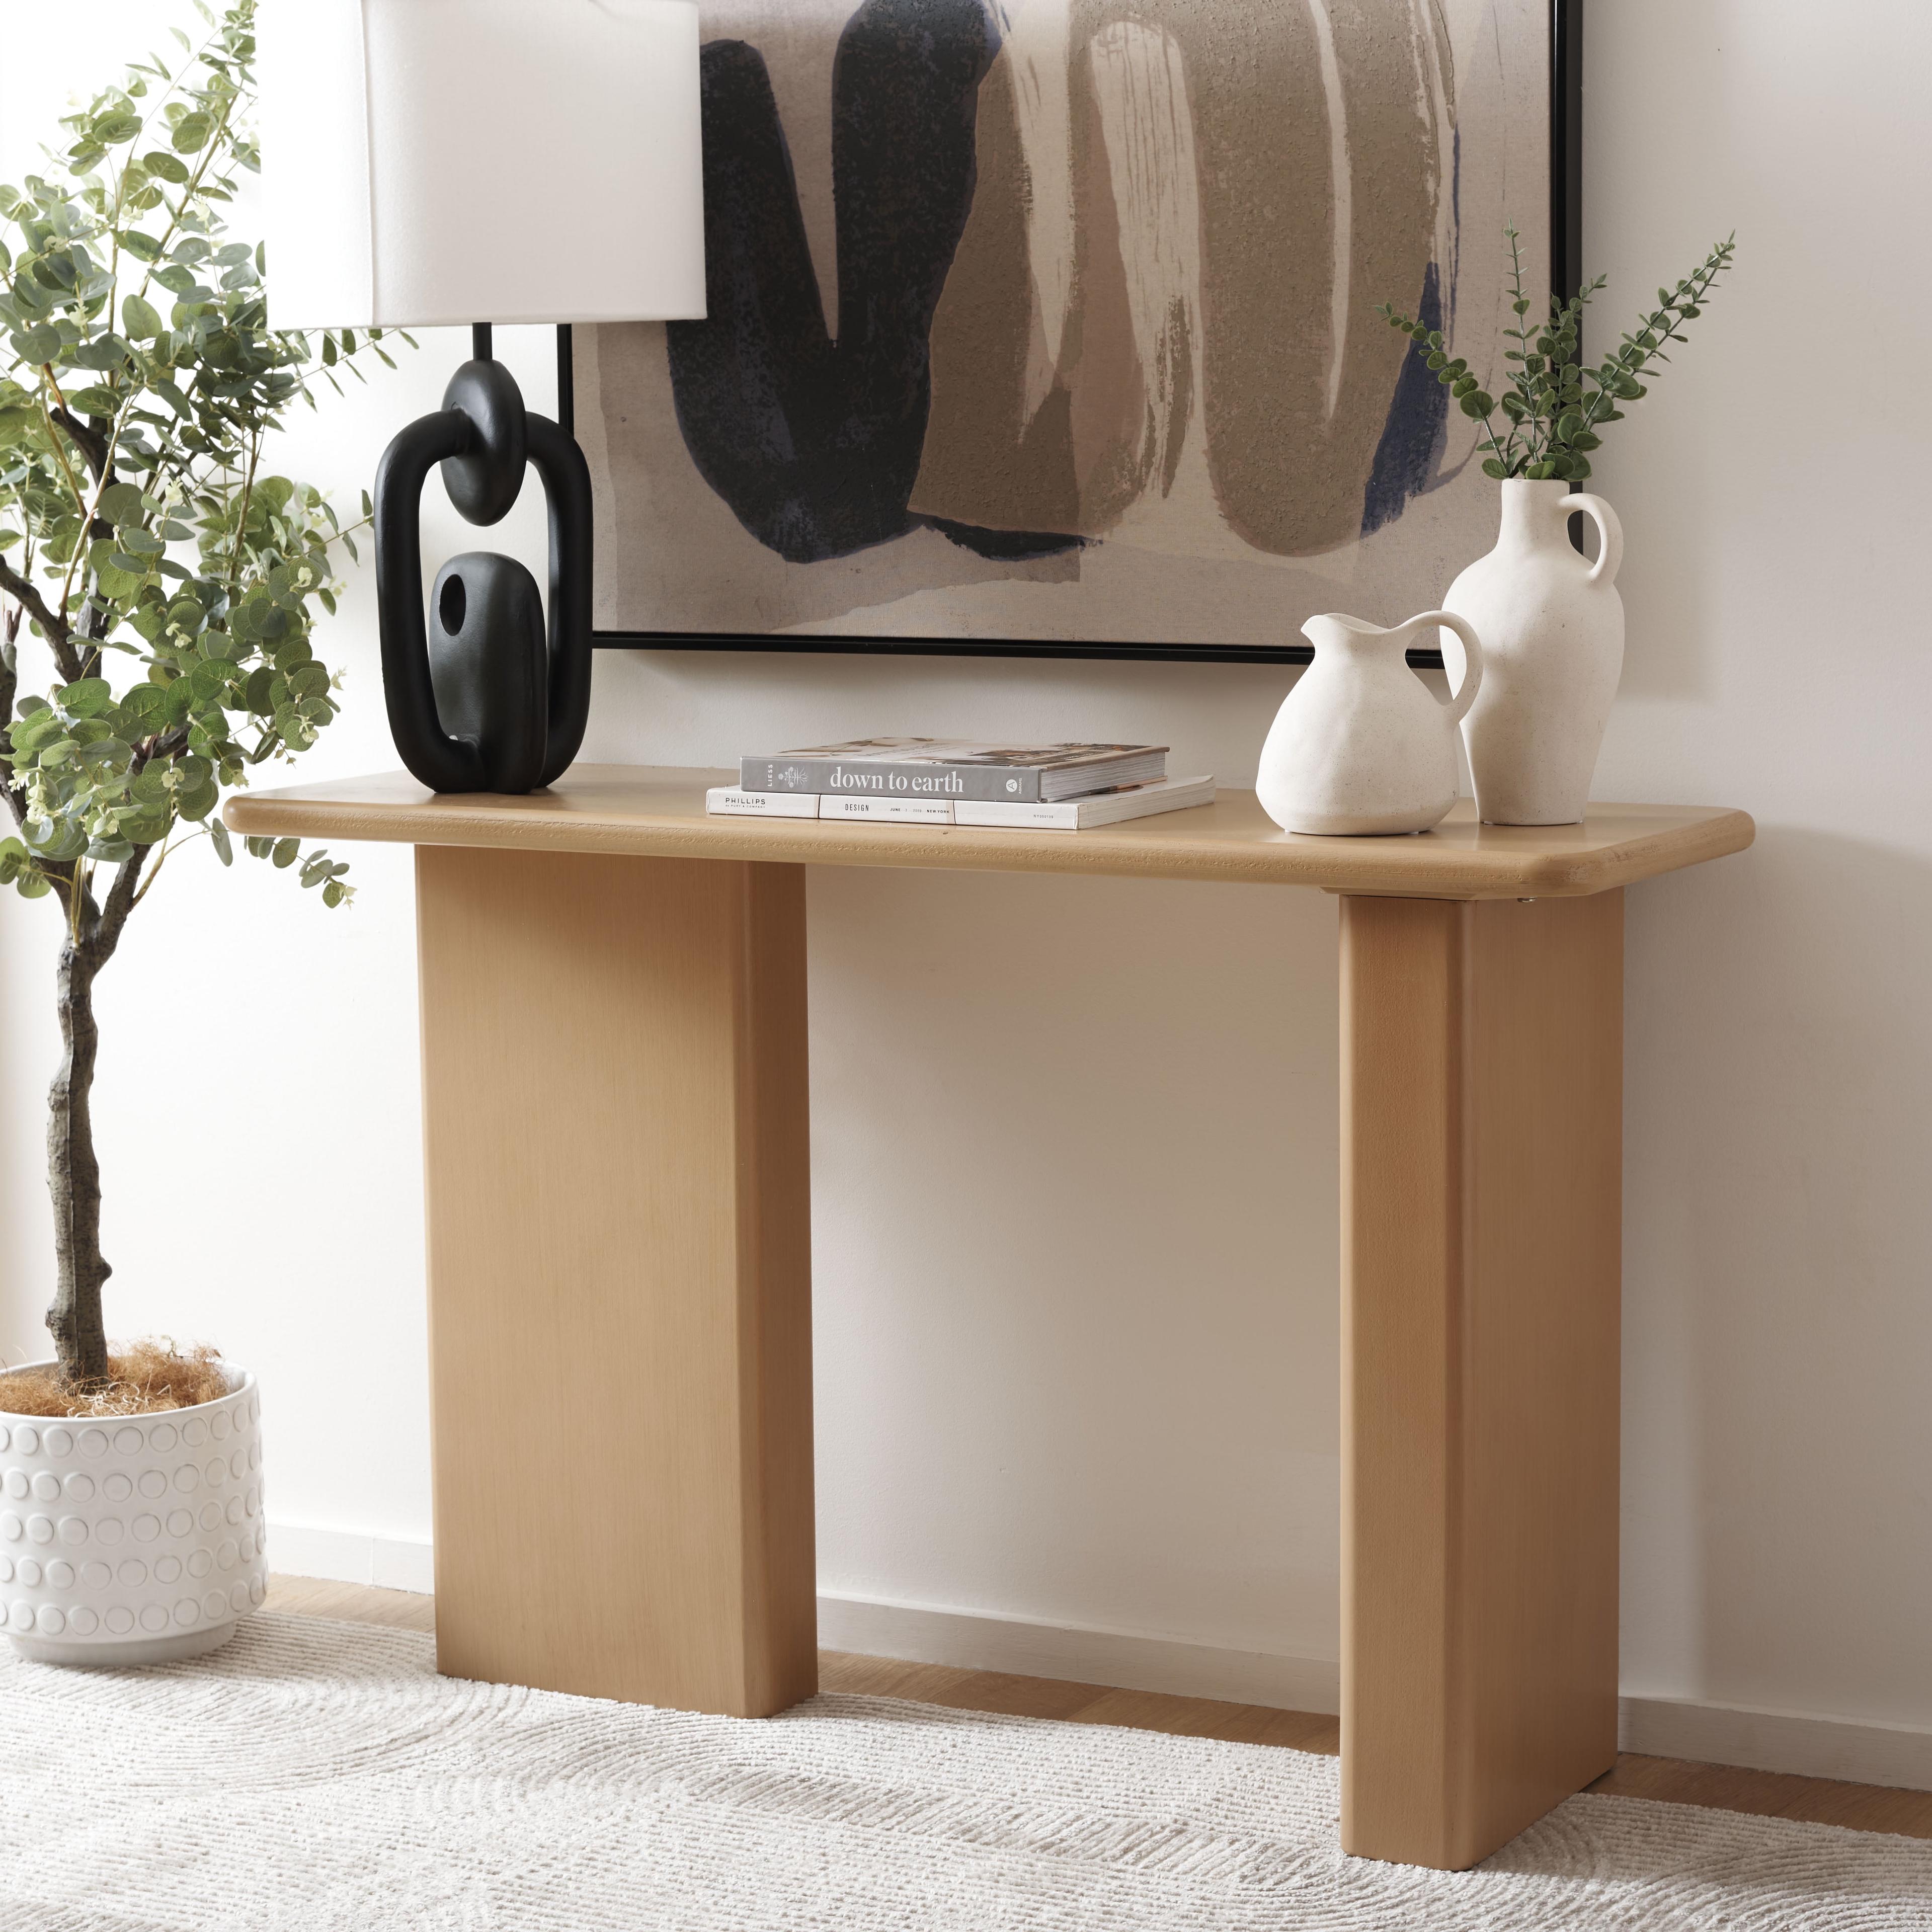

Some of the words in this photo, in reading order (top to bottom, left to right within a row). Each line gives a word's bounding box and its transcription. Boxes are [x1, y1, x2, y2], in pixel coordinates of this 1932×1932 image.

[830, 766, 883, 789] down
[888, 771, 908, 790] to
[912, 771, 964, 793] earth
[845, 803, 869, 812] DESIGN
